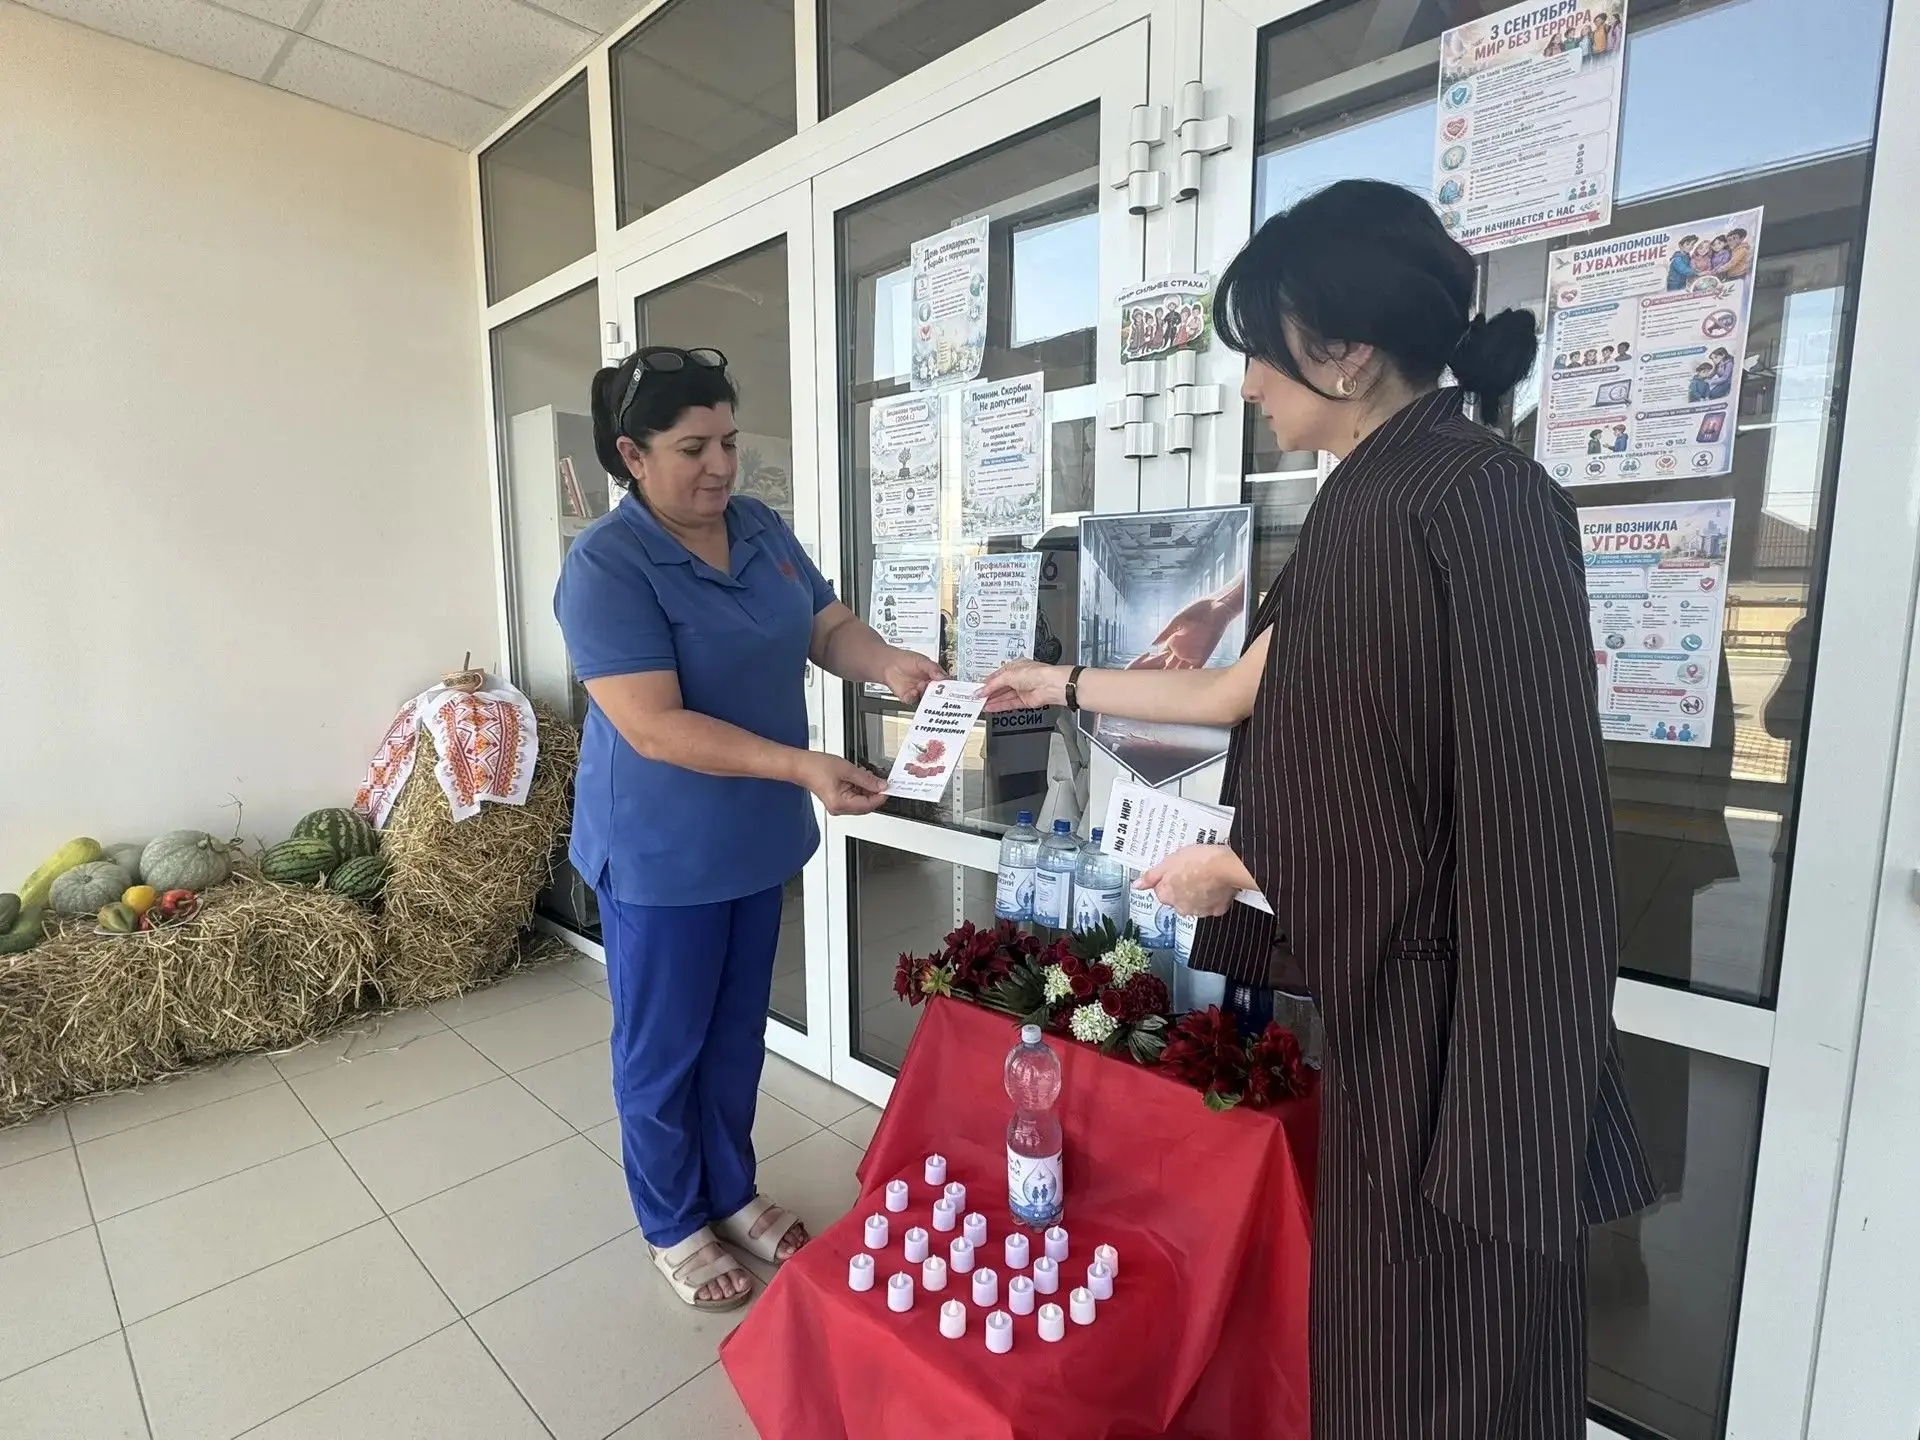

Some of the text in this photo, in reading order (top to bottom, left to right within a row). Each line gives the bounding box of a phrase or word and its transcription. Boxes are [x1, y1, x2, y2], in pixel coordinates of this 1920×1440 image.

[1490, 0, 1578, 40] 3 СЕНТЯБРЯ
[1474, 9, 1592, 61] МИР БЕЗ ТЕРРОРА
[1461, 227, 1482, 240] МИР
[1484, 212, 1545, 234] НАЧИНАЕТСЯ
[1546, 208, 1554, 219] С
[1556, 205, 1575, 218] НАС
[1573, 234, 1671, 262] ВЗАИМОПОМОЩЬ
[1572, 246, 1668, 275] И УВАЖЕНИЕ
[1170, 279, 1208, 289] СТРАХА!
[979, 393, 1028, 411] Не допустим!
[1583, 519, 1678, 535] ЕСЛИ ВОЗНИКЛА
[1591, 532, 1671, 552] УГРОЗА
[974, 561, 1027, 572] Профилактика
[980, 580, 1002, 588] важно
[935, 684, 945, 695] 3
[924, 708, 972, 719] солидарности
[942, 702, 961, 710] День
[934, 718, 959, 726] борьбе
[992, 713, 1043, 728] РОССИИ
[919, 725, 966, 735] терроризмом
[1114, 798, 1134, 852] МЫ ЗА МИР!
